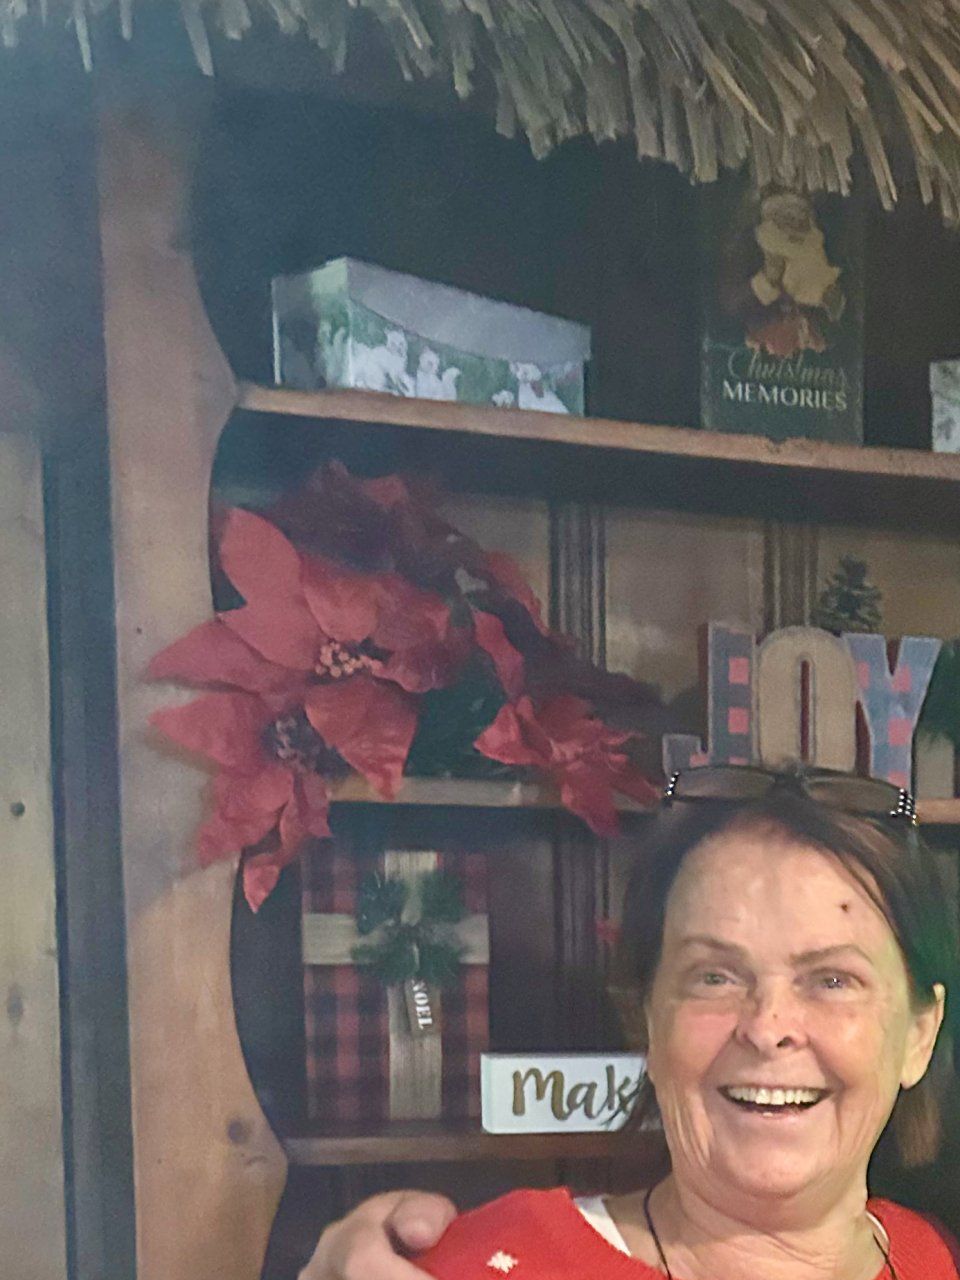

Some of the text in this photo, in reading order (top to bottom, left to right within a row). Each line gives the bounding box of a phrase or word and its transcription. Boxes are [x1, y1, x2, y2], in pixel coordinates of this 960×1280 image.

[722, 379, 848, 412] MEMORIES
[662, 620, 943, 796] JOY
[411, 979, 433, 1030] NOEL
[511, 1065, 640, 1123] Mak
